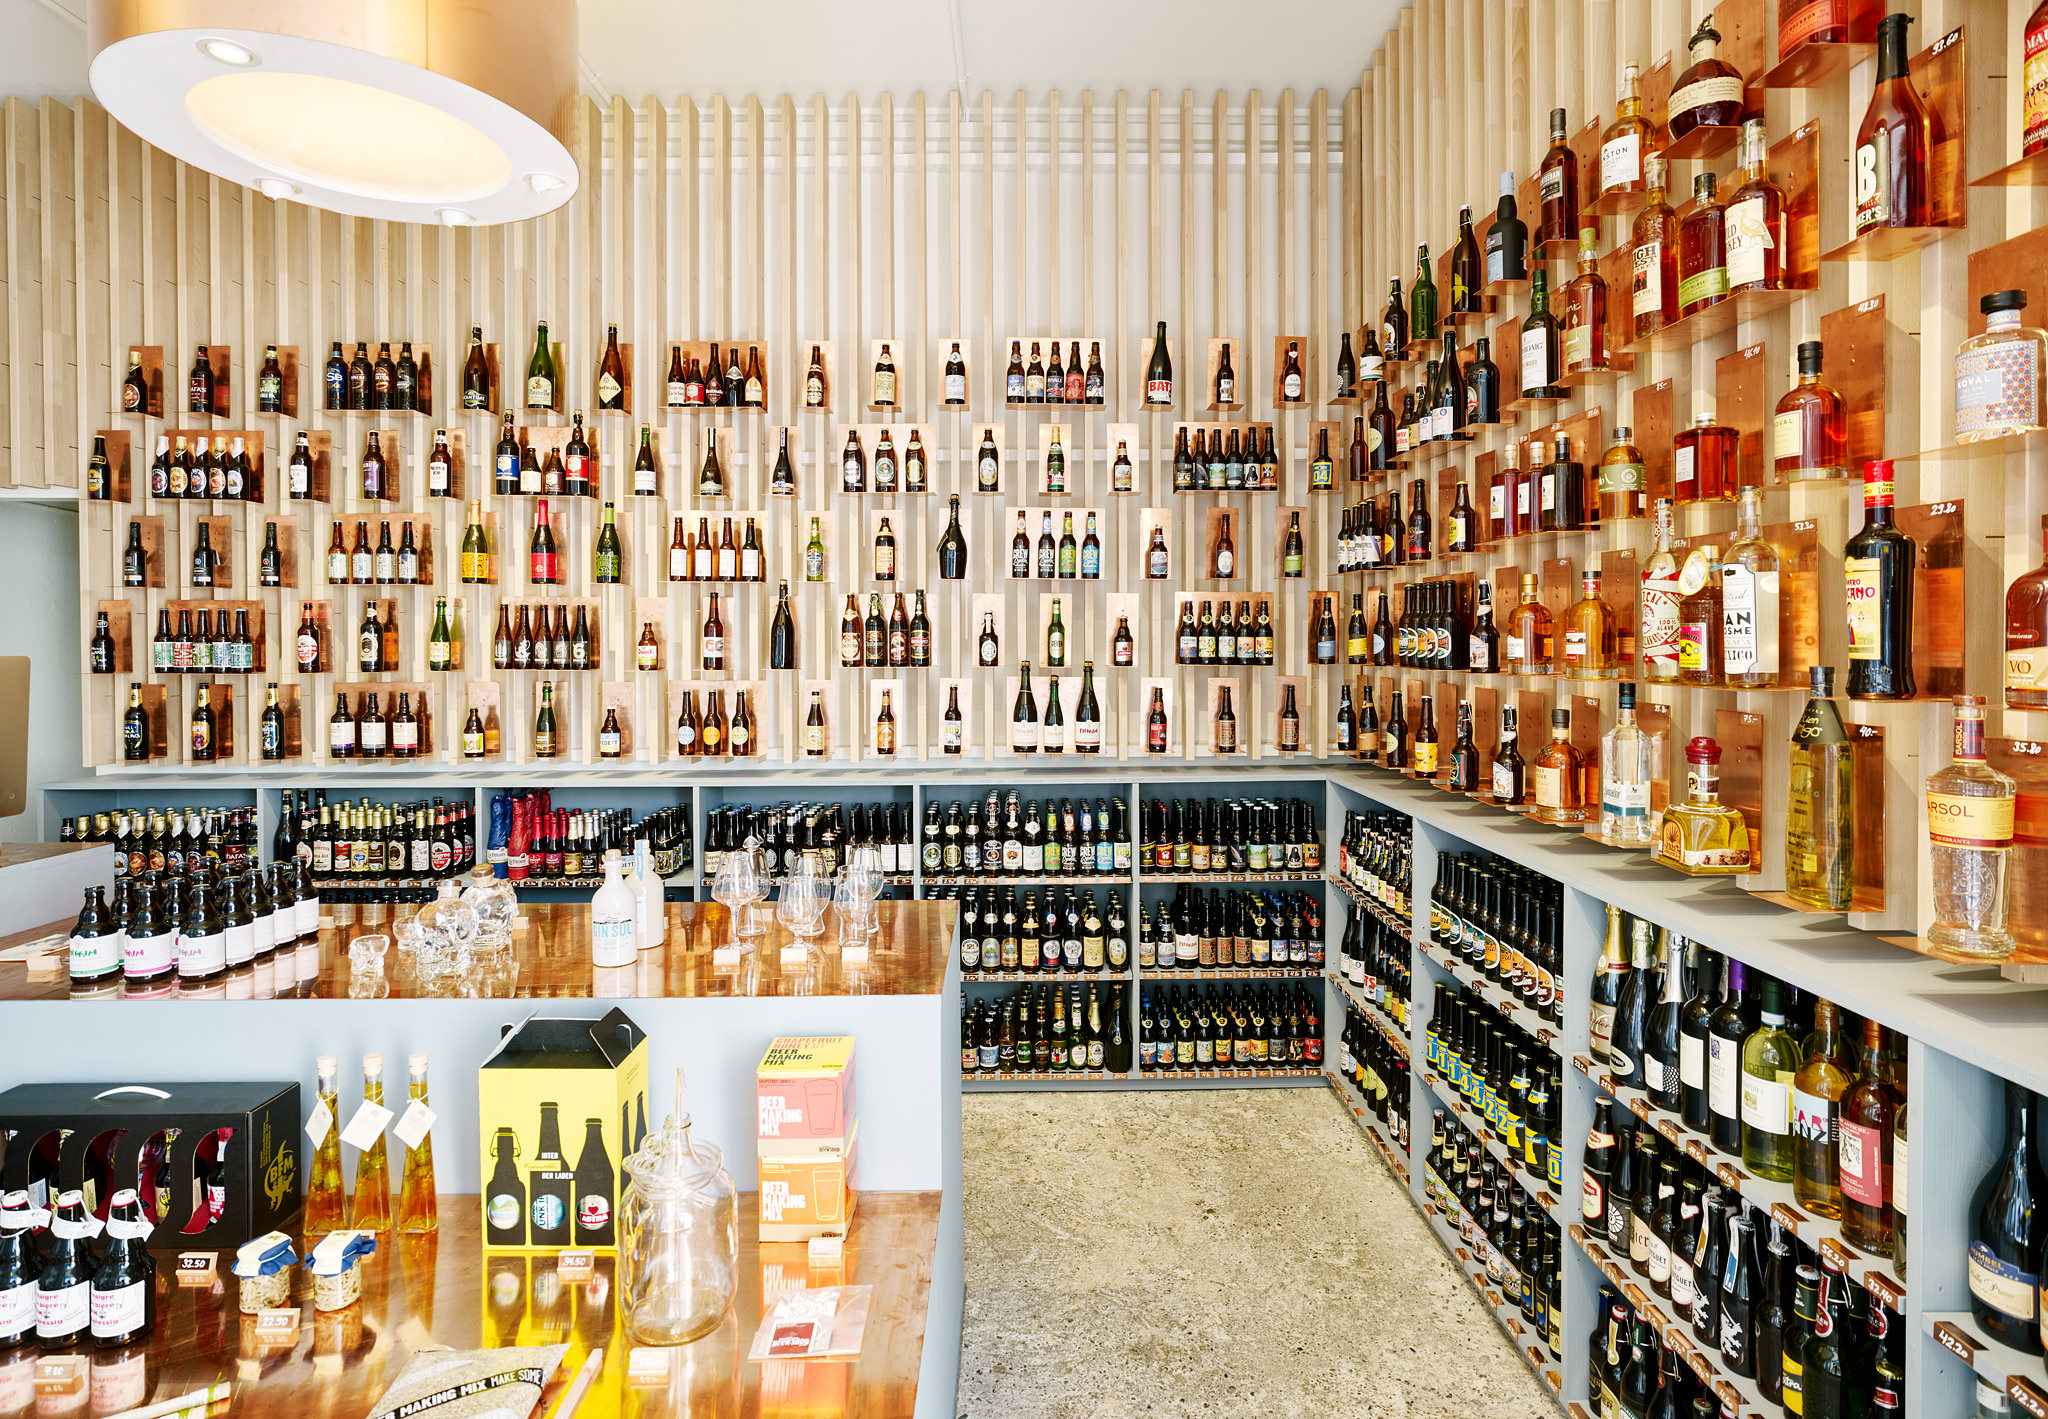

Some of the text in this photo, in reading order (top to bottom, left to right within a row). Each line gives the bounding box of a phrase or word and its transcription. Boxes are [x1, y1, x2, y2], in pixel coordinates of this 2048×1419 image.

[1931, 32, 1959, 55] 93.60
[1857, 144, 1877, 205] B
[1313, 470, 1328, 482] 04
[1930, 502, 1957, 516] 29.80
[1794, 521, 1815, 531] 53.30
[2008, 659, 2032, 675] VO
[1954, 721, 1962, 756] BARSOL
[2012, 741, 2042, 755] 35.80
[593, 921, 633, 939] GIN SUL
[775, 1037, 843, 1045] GRAPEFRUIT
[1461, 1073, 1470, 1092] 4
[1472, 1085, 1482, 1103] 4
[758, 1096, 786, 1110] BEER
[1485, 1098, 1496, 1117] 2
[758, 1108, 802, 1123] MAKING
[1498, 1112, 1509, 1131] 2
[759, 1121, 781, 1136] MIX
[270, 1154, 294, 1180] BFM
[762, 1181, 789, 1195] BEER
[762, 1194, 806, 1209] MAKING
[762, 1207, 784, 1222] MIX
[181, 1258, 206, 1269] 32.50
[1821, 1244, 1846, 1266] 56.20
[1867, 1278, 1893, 1303] 32.40
[261, 1316, 288, 1327] 22.90
[1938, 1329, 1968, 1358] 42.20
[399, 1388, 458, 1418] MAKING
[460, 1379, 488, 1396] MIX
[490, 1371, 517, 1388] MAKE
[517, 1368, 542, 1385] SOME
[2010, 1385, 2045, 1418] 42.20
